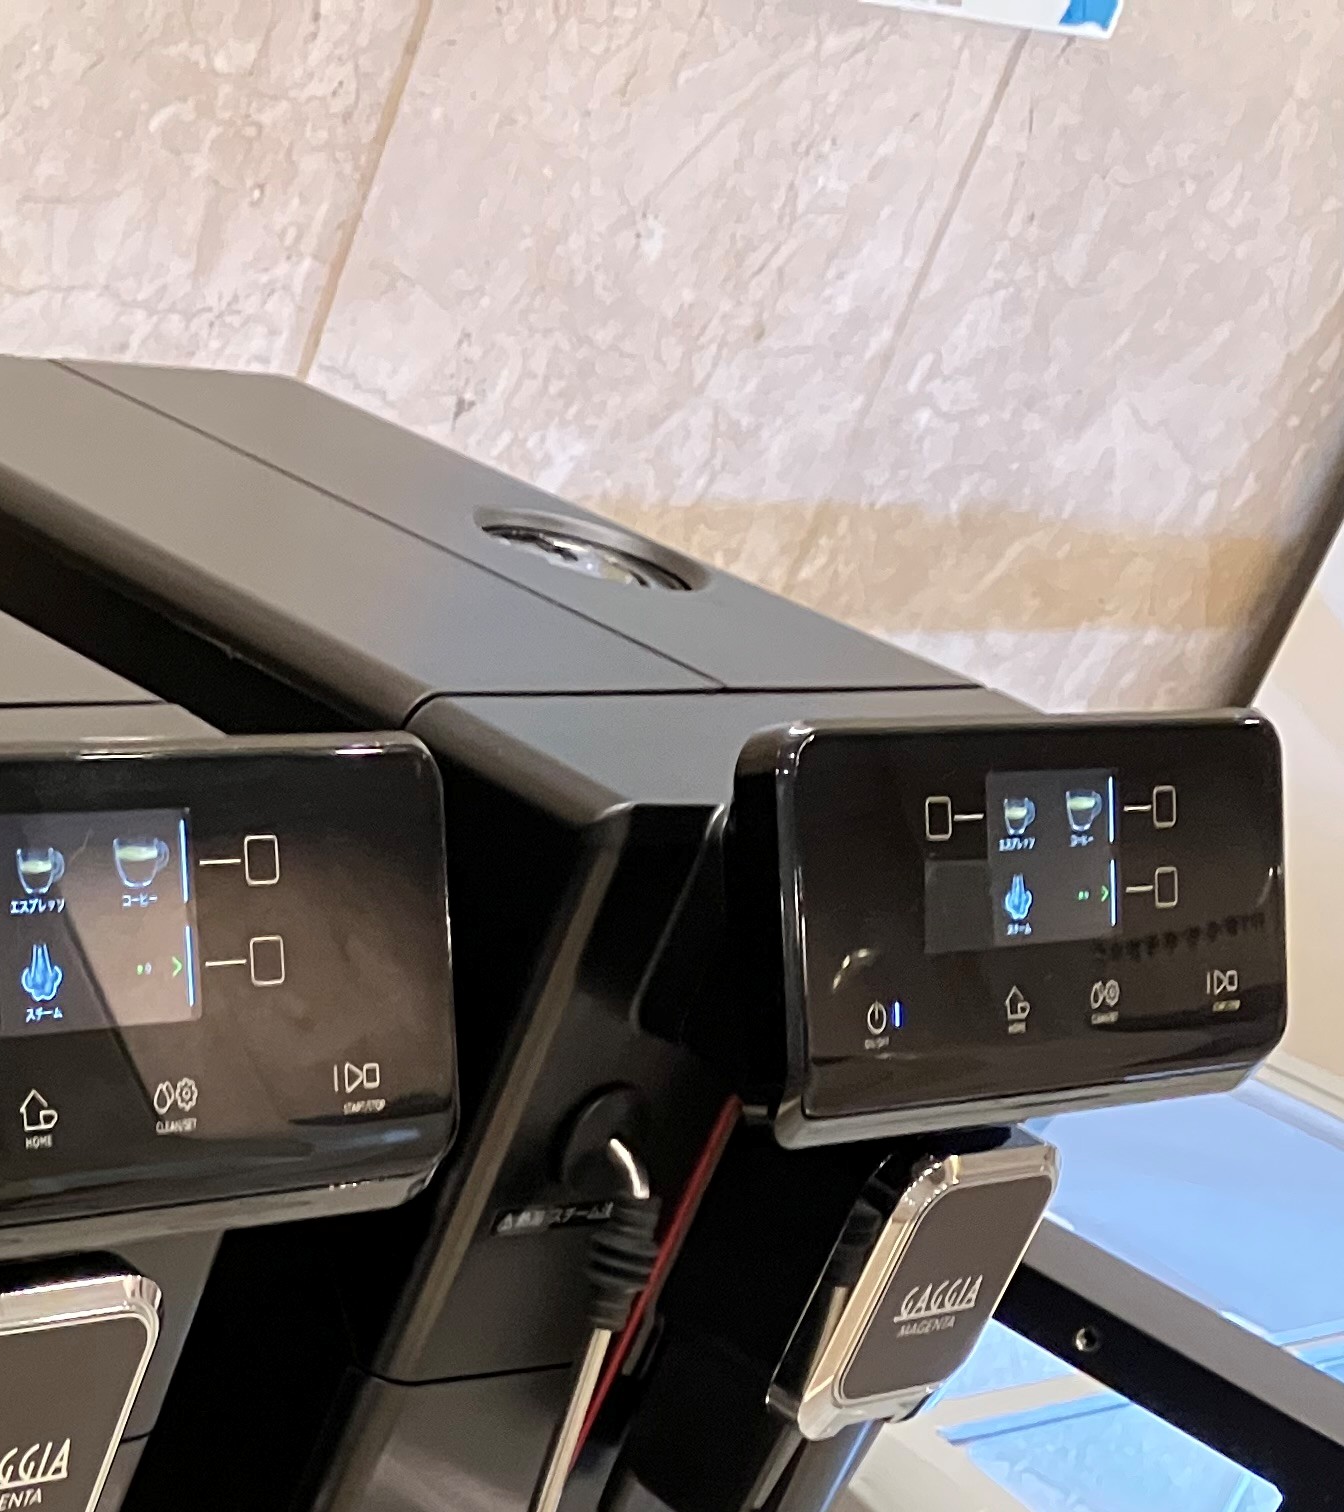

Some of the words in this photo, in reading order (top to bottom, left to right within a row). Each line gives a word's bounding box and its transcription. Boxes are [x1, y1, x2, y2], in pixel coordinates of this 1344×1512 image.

[10, 898, 65, 914] エスプレッソ
[25, 1006, 63, 1023] スチーム
[895, 1274, 984, 1322] GAGGIA
